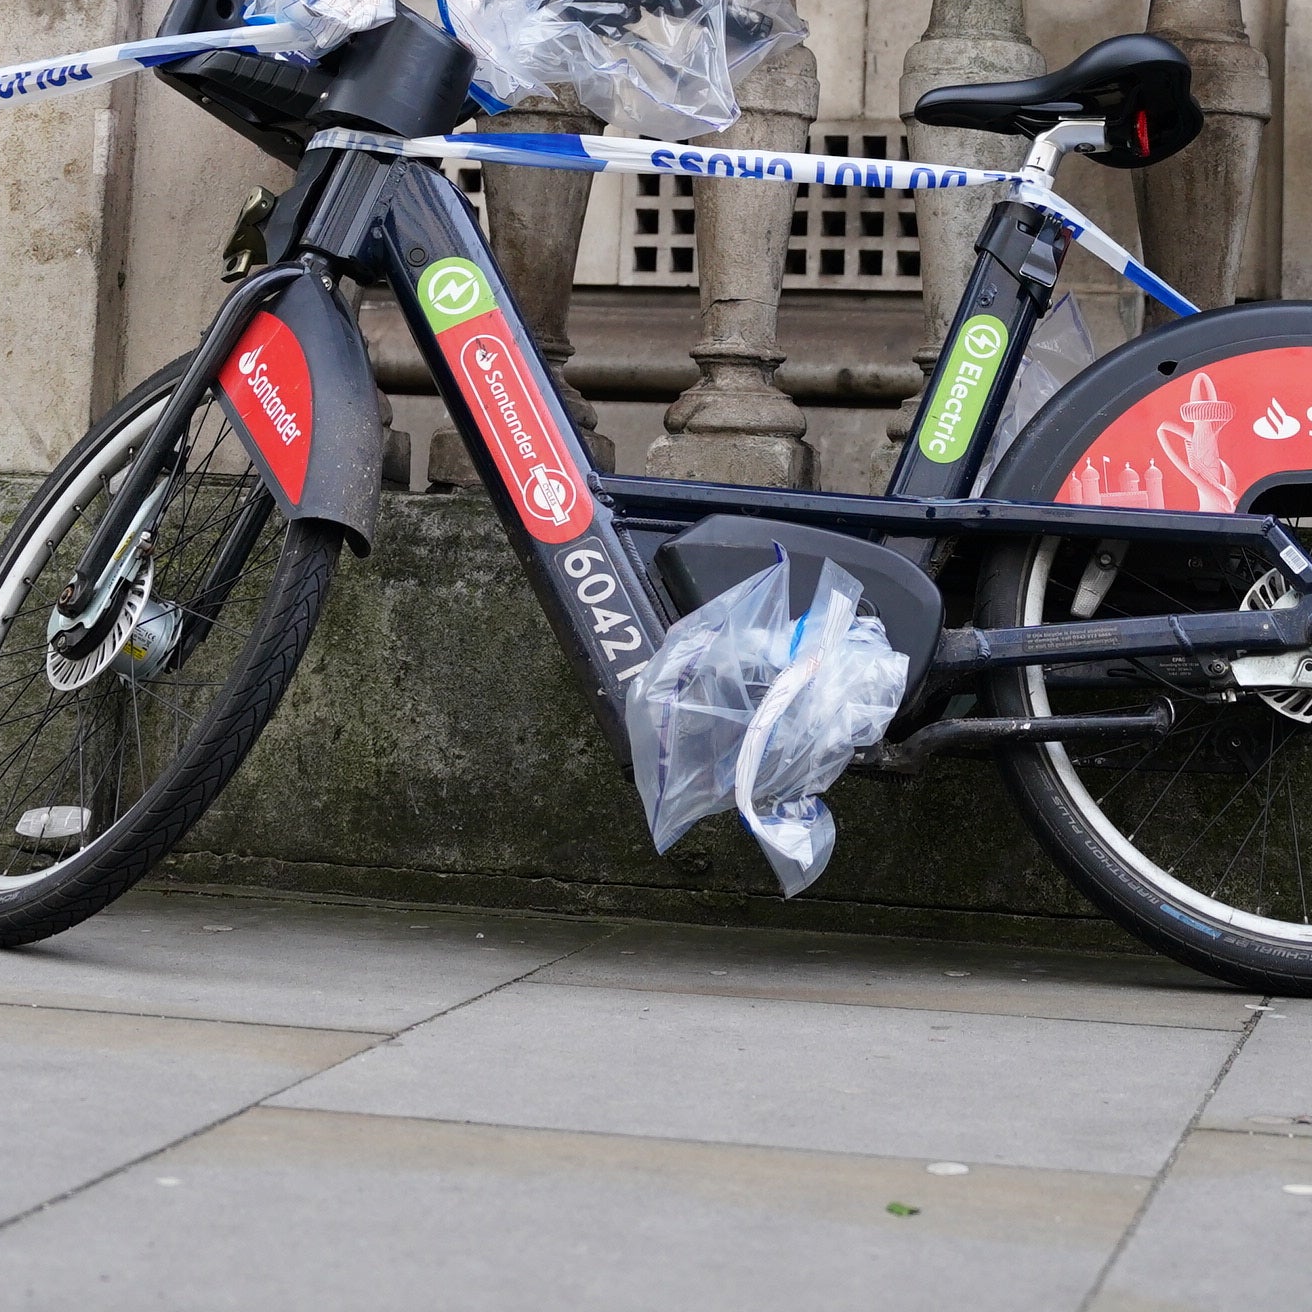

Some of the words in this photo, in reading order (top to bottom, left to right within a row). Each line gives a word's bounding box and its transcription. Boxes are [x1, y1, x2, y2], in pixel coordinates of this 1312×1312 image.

[246, 362, 301, 447] Santander
[484, 369, 538, 461] Santander
[928, 360, 984, 456] Electric
[541, 482, 558, 507] CYCLES
[1050, 794, 1084, 837] PLUS
